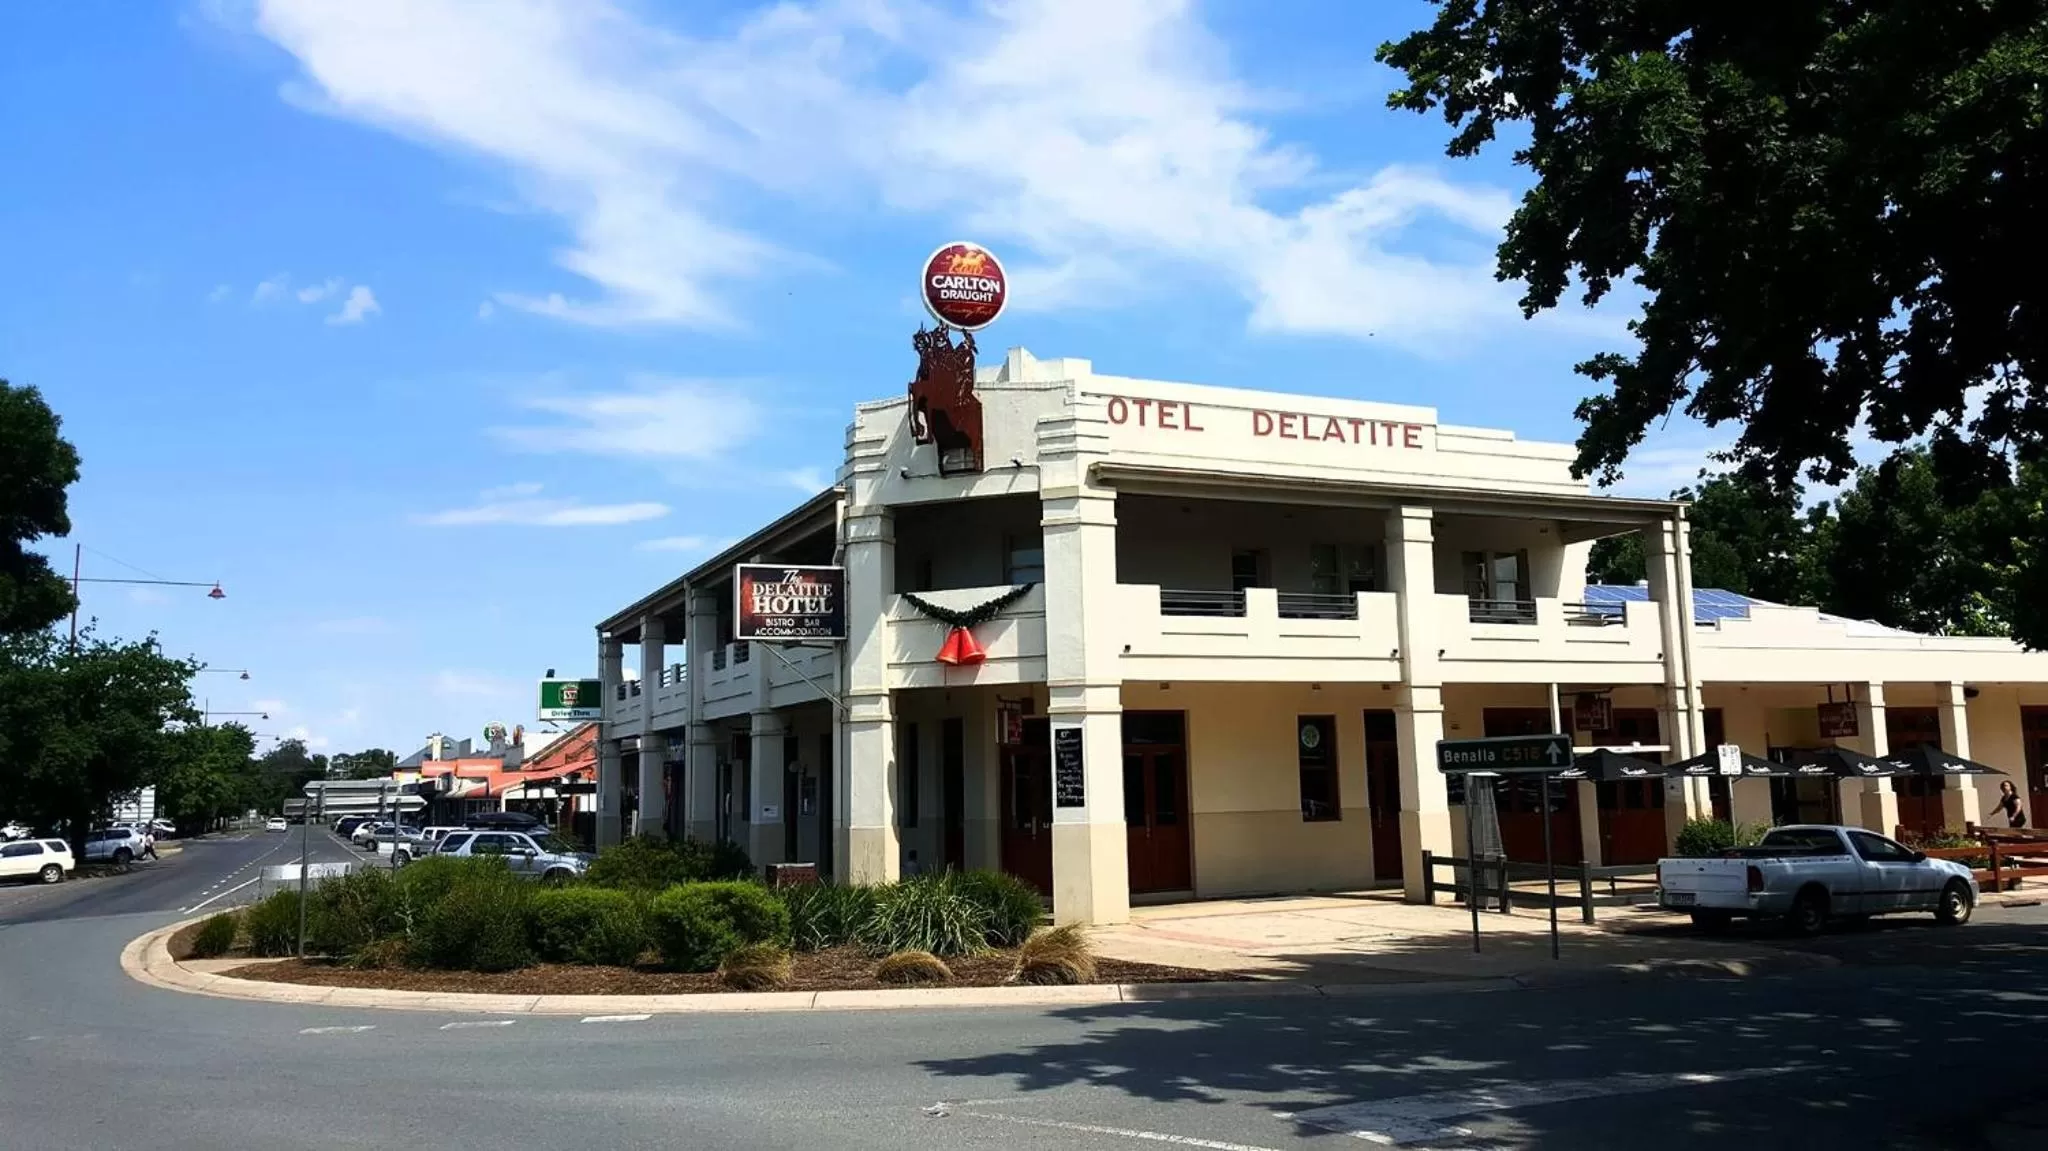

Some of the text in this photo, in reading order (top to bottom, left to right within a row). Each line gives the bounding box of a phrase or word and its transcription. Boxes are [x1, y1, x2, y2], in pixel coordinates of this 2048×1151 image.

[931, 275, 1000, 293] CARLTON
[940, 289, 994, 303] DRAUGHT
[1107, 395, 1423, 449] OTEL DELATITE
[751, 596, 834, 614] HOTEL
[765, 618, 821, 627] BISTRO BAR
[754, 628, 833, 636] ACCOMMODATION
[1443, 748, 1497, 763] Benalla
